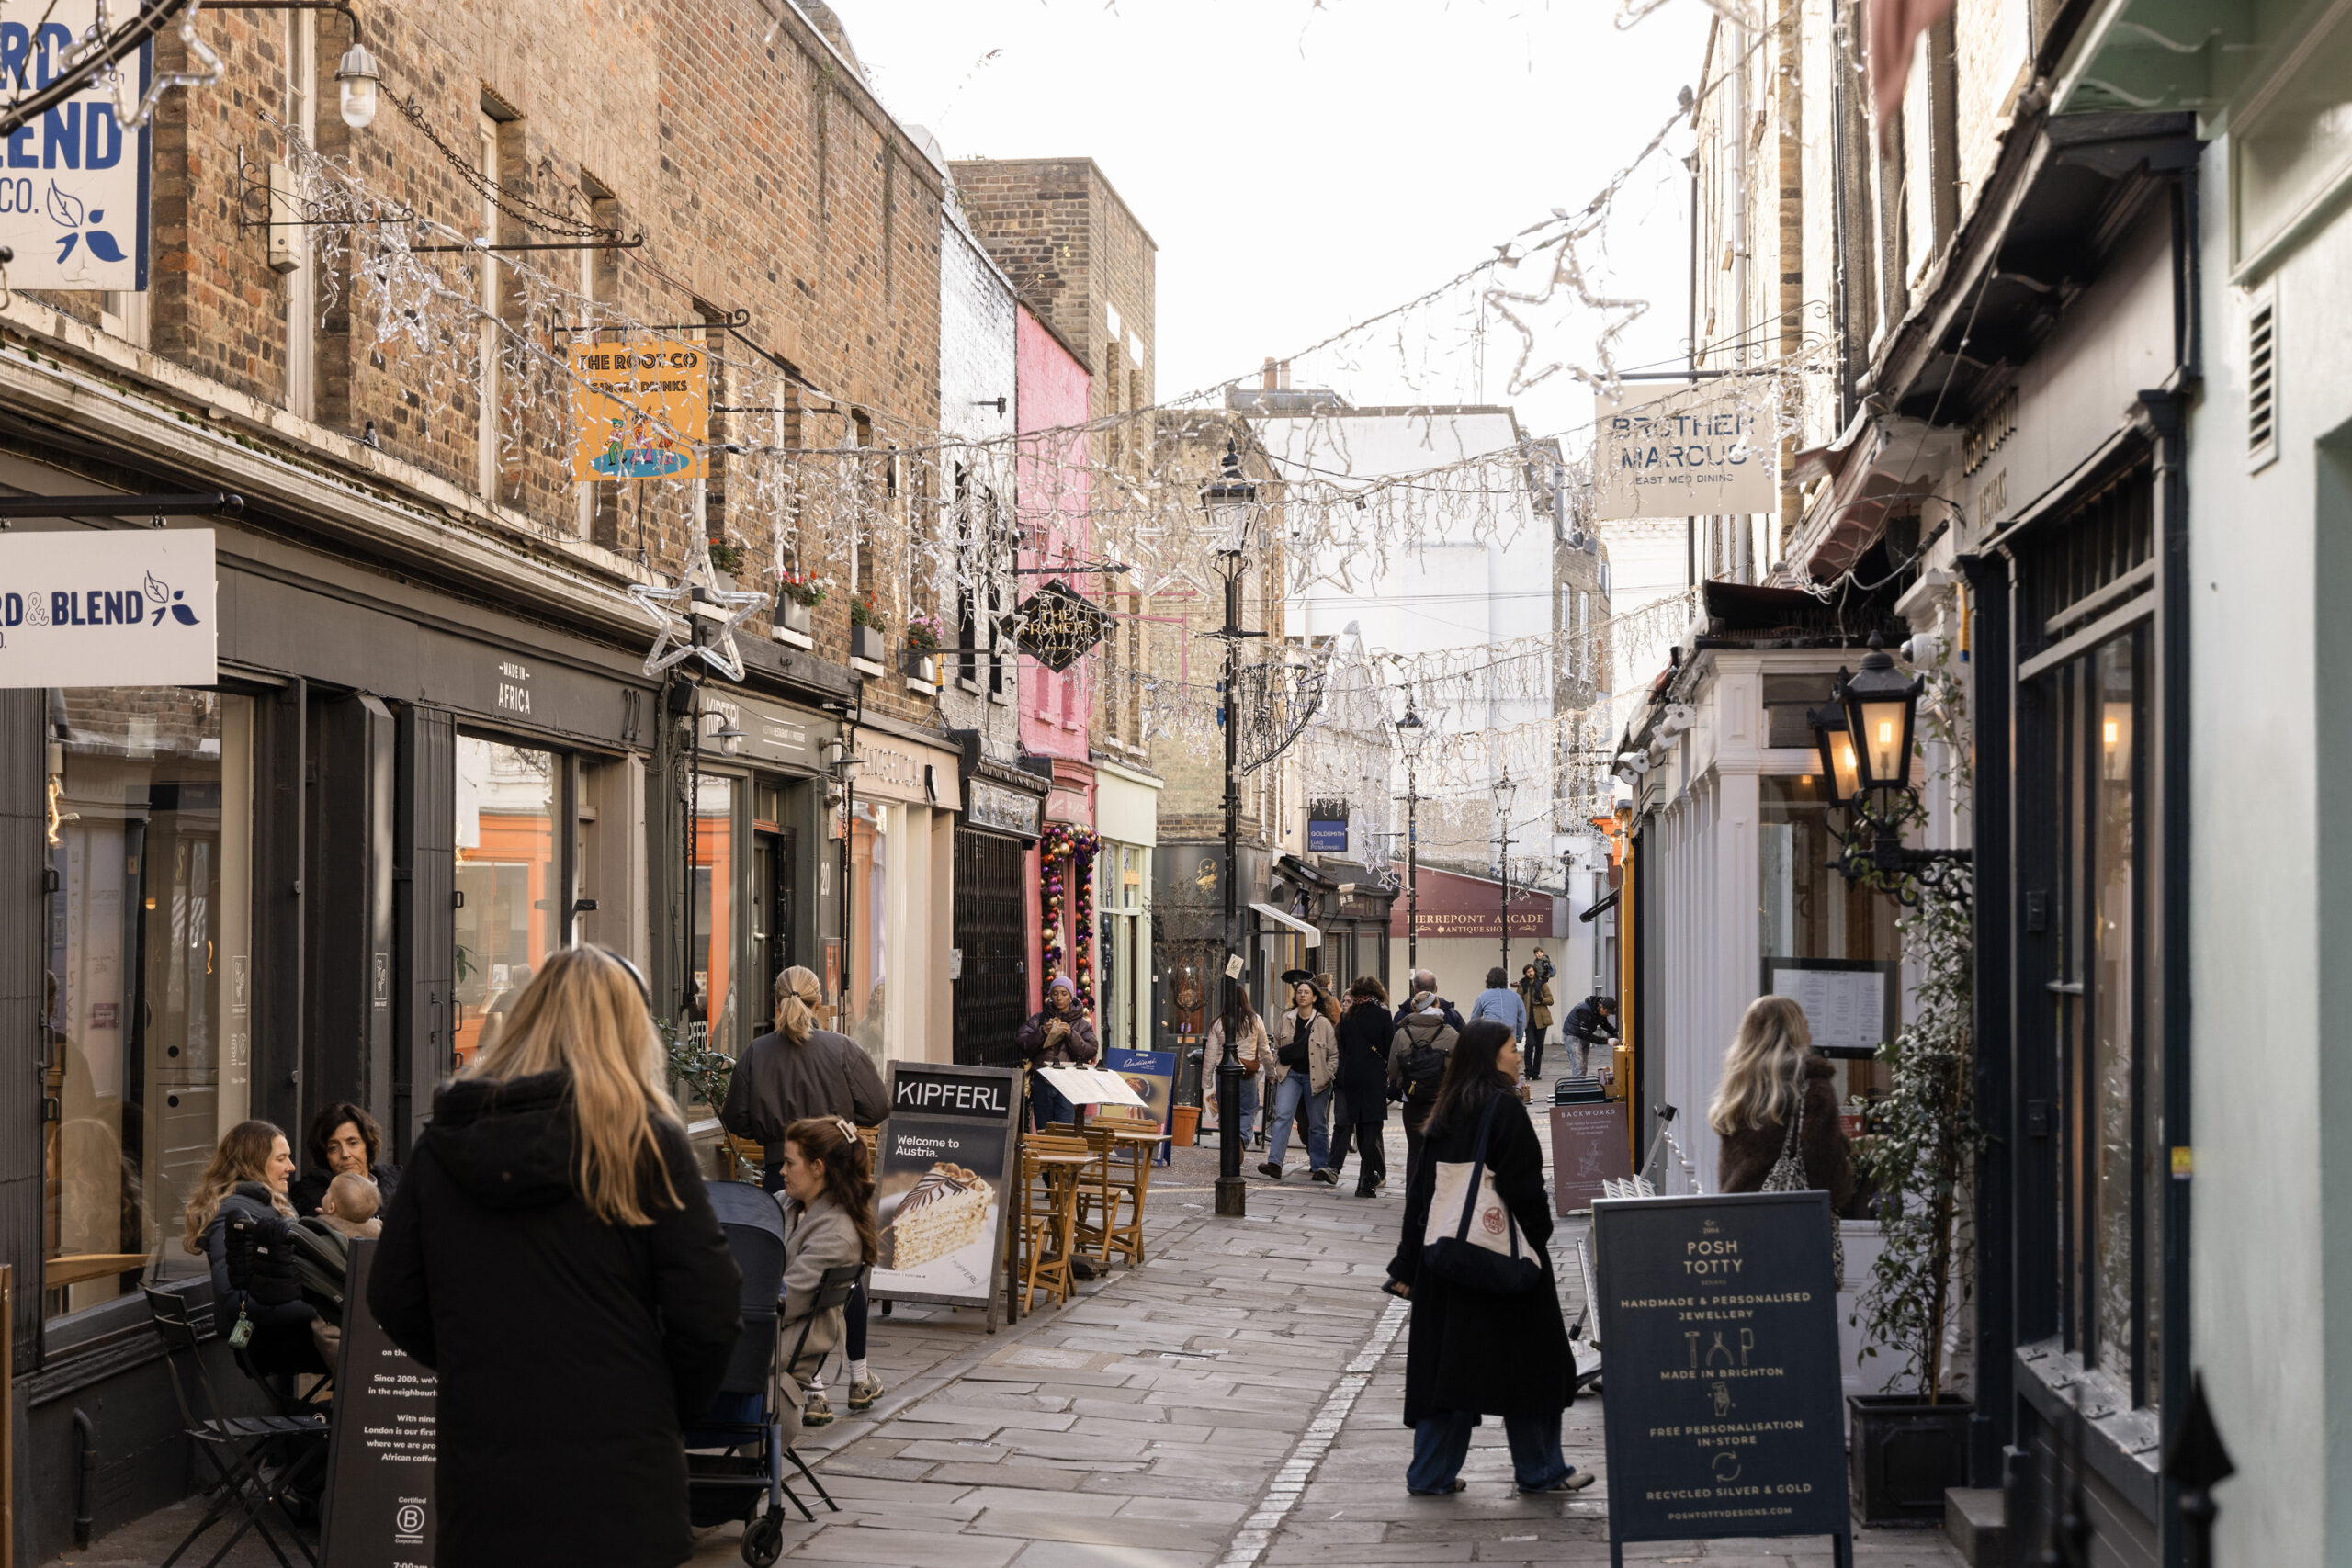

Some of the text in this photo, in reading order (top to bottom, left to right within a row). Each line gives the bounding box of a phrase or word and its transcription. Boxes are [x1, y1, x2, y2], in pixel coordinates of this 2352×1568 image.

[0, 101, 123, 170] END
[580, 352, 698, 370] THE ROOT CO
[1621, 445, 1747, 468] MARCUS
[1635, 476, 1664, 485] EAST
[1668, 474, 1692, 484] MED
[51, 591, 143, 626] BLEND
[1041, 609, 1071, 622] THE
[498, 682, 530, 715] AFRICA
[820, 862, 831, 896] 20
[1494, 914, 1544, 924] ARCADE
[897, 1081, 1007, 1111] KIPFERL
[1561, 1109, 1615, 1118] BACKWORKS
[897, 1134, 960, 1149] Welcome to
[895, 1145, 939, 1158] Austria.
[1687, 1240, 1738, 1256] POSH
[1683, 1258, 1744, 1275] TOTTY
[1621, 1292, 1812, 1309] HANDMADE & PERSONALISED
[1679, 1310, 1754, 1321] JEWELLERY
[374, 1374, 395, 1382] Since
[397, 1374, 419, 1384] 2009,
[1660, 1367, 1785, 1380] MADE IN BRIGHTON
[368, 1386, 376, 1395] in
[378, 1387, 391, 1396] the
[397, 1414, 436, 1424] With nine
[364, 1426, 394, 1435] London
[395, 1427, 402, 1435] is
[1649, 1420, 1804, 1438] FREE PERSONALISATION
[367, 1440, 392, 1449] where
[1697, 1435, 1758, 1447] IN-STORE
[381, 1452, 437, 1463] African coffee
[1646, 1483, 1813, 1501] RECYCLED SILVER & GOLD
[404, 1510, 418, 1528] B
[1668, 1506, 1793, 1520] POSHTOTTYDESIGNS.COM
